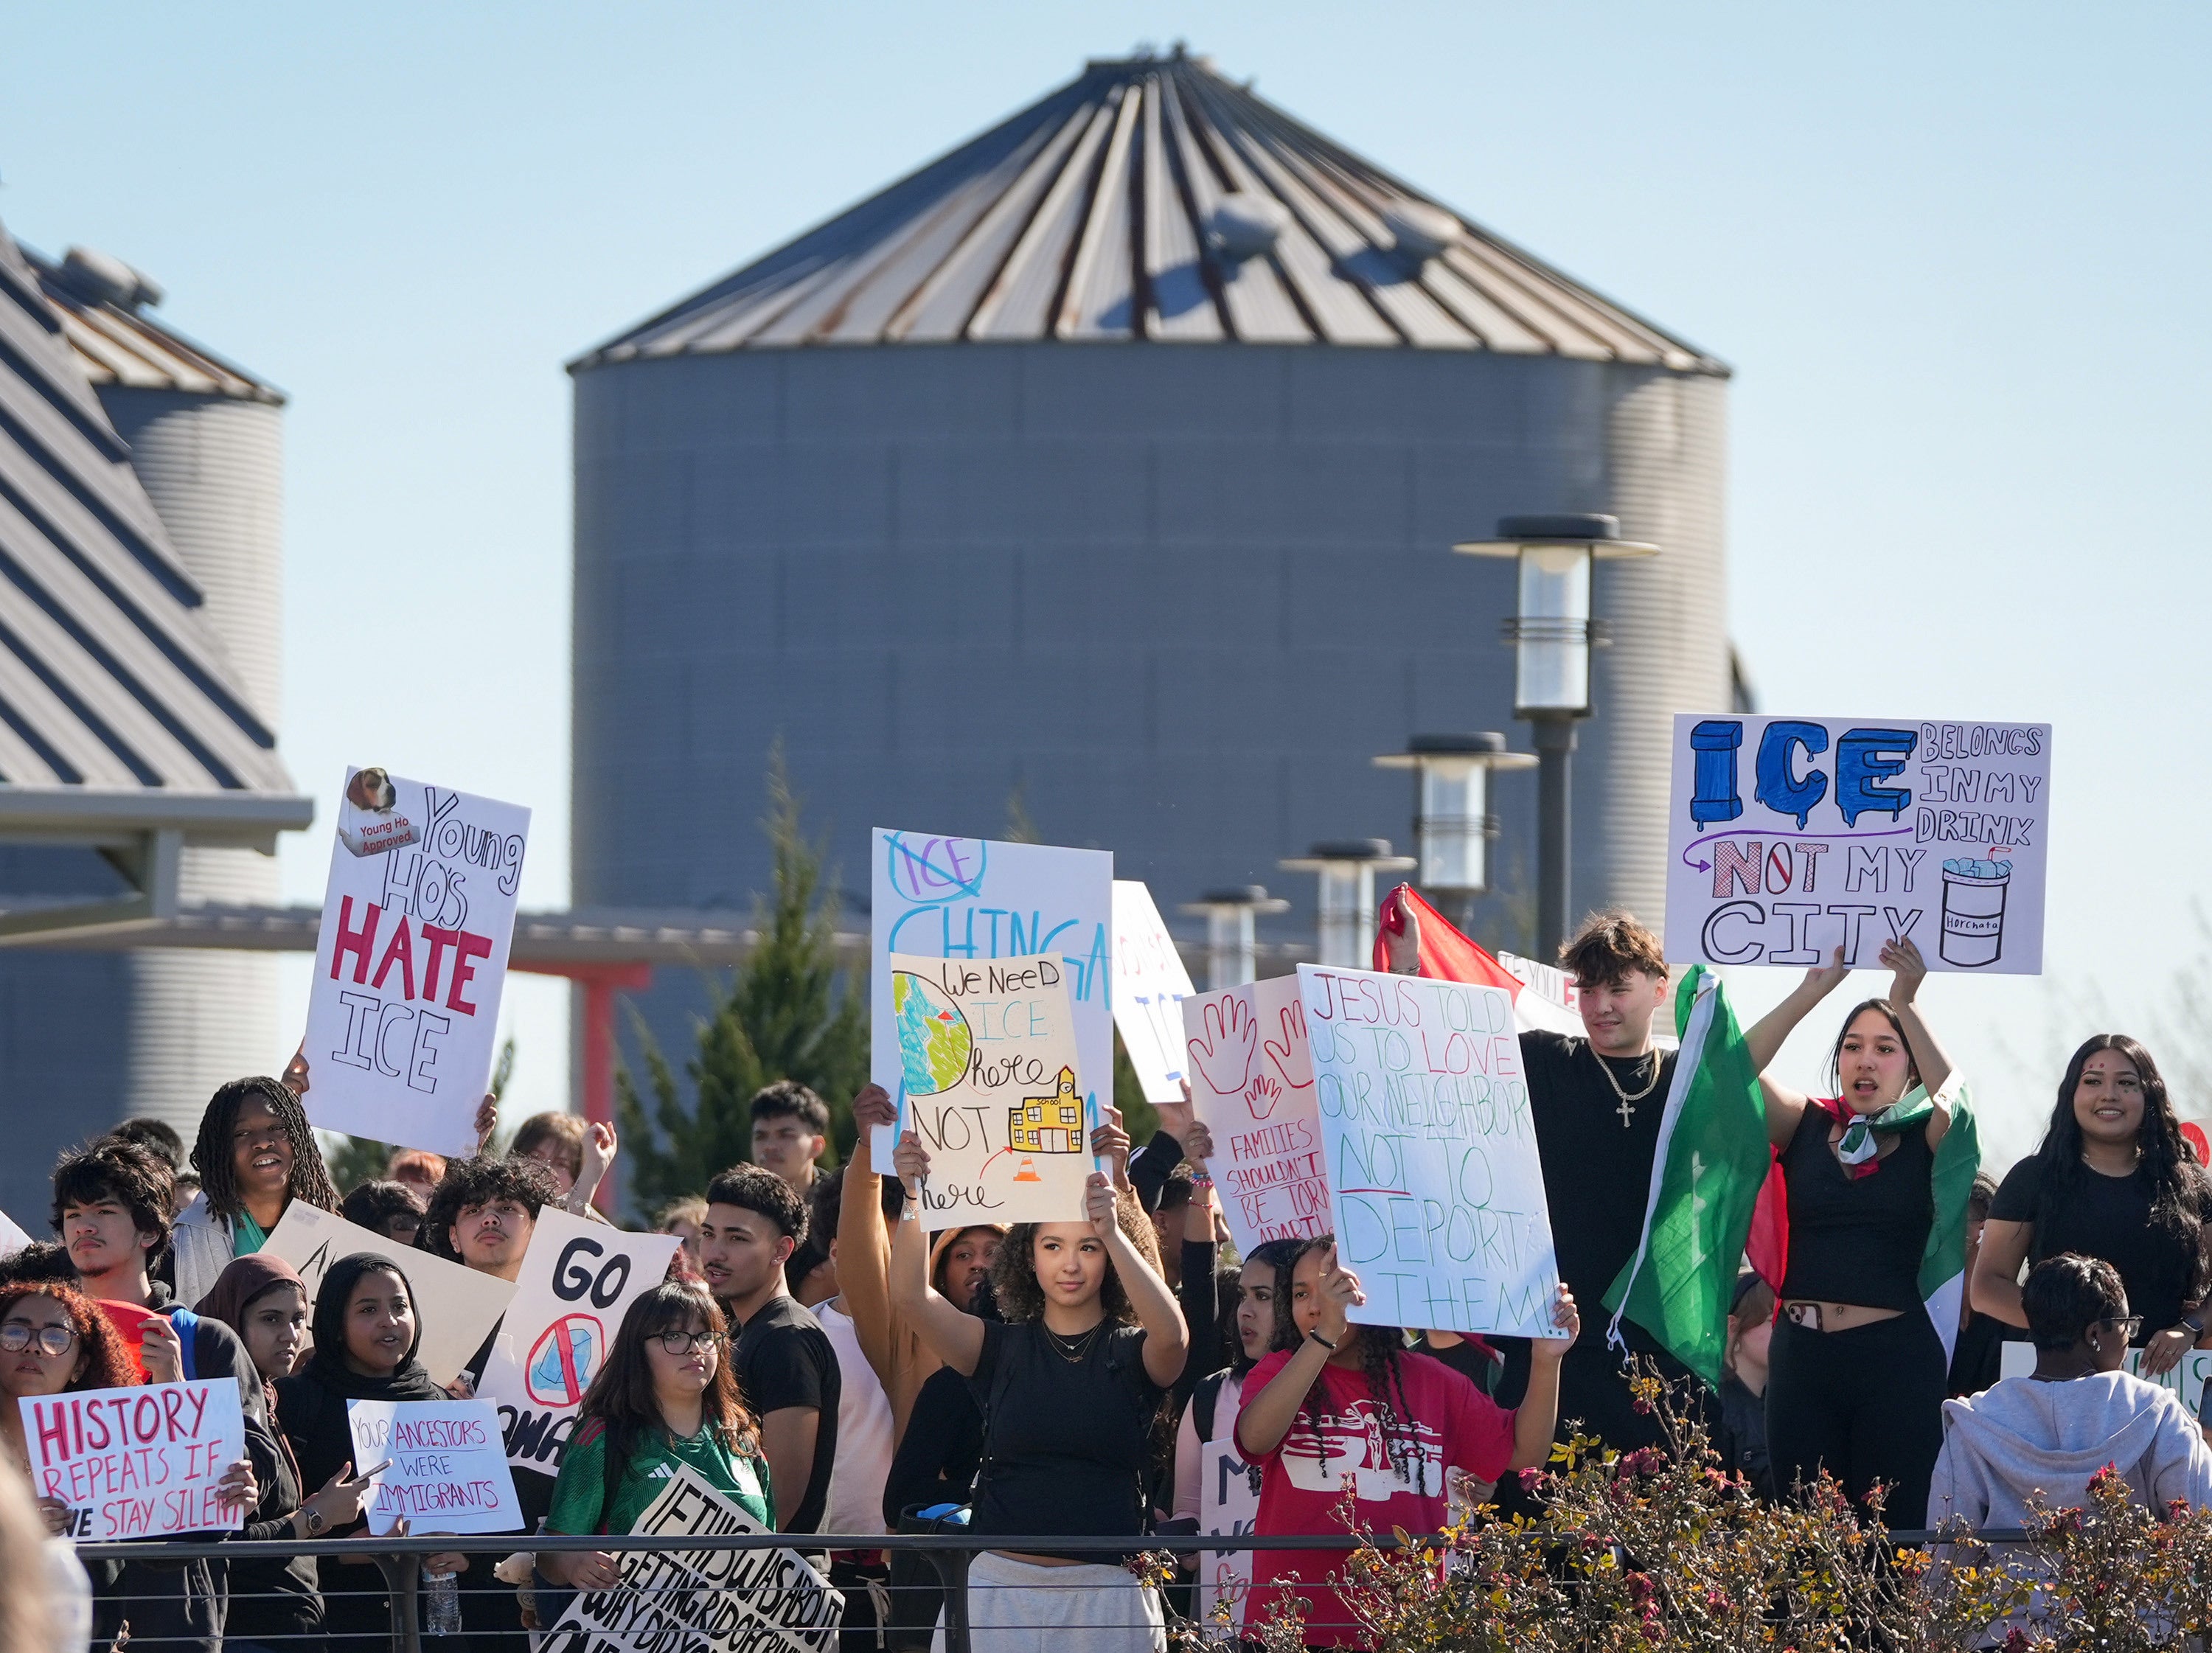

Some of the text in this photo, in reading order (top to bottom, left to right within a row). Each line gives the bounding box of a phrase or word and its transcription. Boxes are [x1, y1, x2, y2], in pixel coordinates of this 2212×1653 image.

[1919, 723, 2044, 763] BELONGS
[1690, 720, 1919, 832] ICE
[360, 816, 409, 838] Young Ho
[362, 829, 412, 853] Approved
[422, 787, 525, 897] Young
[1916, 807, 2035, 846] DRINK
[901, 838, 974, 895] ICE
[1711, 841, 1927, 898] NOT MY
[1701, 900, 1924, 965] CITY
[1946, 915, 1999, 930] Horchata
[330, 894, 493, 1017] HATE
[970, 1000, 1048, 1040] ICE
[1313, 972, 1420, 1027] JESUS
[1425, 985, 1506, 1034] TOLD
[332, 990, 451, 1094] ICE
[972, 1048, 1060, 1088] here
[1310, 1023, 1517, 1075] US TO LOVE
[911, 1101, 990, 1153] NOT
[1318, 1071, 1537, 1143] OUR NEIGHBOR
[1231, 1118, 1313, 1162] FAMILIES
[921, 1173, 1005, 1210] here
[1226, 1151, 1320, 1195] SHOULDN'T
[1340, 1129, 1492, 1209] NOT TO
[1240, 1191, 1273, 1229] BE
[1340, 1195, 1525, 1272] DEPORT
[552, 1236, 631, 1309] GO
[34, 1388, 209, 1466] HISTORY
[351, 1417, 486, 1451] YOUR ANCESTORS
[43, 1440, 223, 1504] REPEATS IF
[400, 1455, 453, 1477] WERE
[102, 1497, 156, 1537] STAY
[372, 1480, 499, 1514] IMMIGRANTS
[642, 1478, 702, 1536] IF
[723, 1534, 796, 1615] WAS
[768, 1569, 844, 1653] ABOUT
[614, 1550, 709, 1624] GETTING
[691, 1590, 740, 1640] RID
